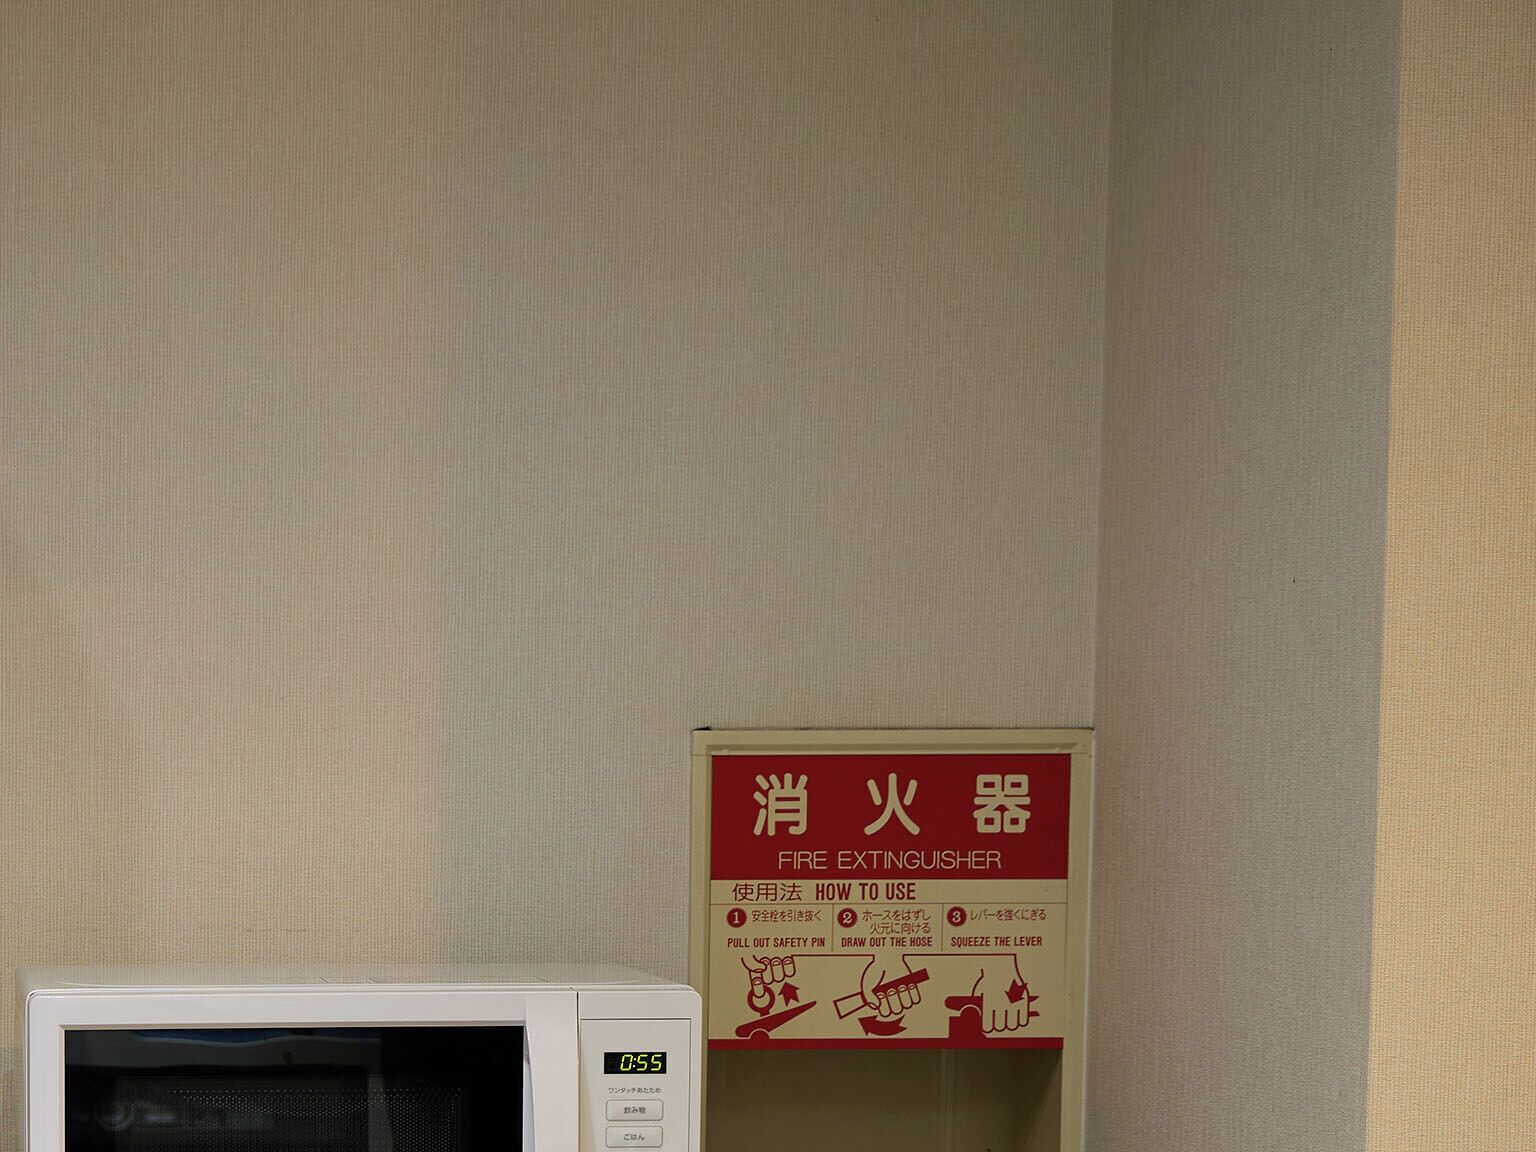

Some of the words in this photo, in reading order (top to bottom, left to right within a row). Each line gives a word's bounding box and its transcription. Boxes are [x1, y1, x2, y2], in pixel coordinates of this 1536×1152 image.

[778, 851, 827, 870] FIRE
[837, 850, 1002, 870] EXTINGUISHER
[732, 883, 802, 902] 使用法
[816, 883, 852, 900] HOW
[859, 883, 879, 900] TO
[886, 883, 916, 900] USE
[751, 909, 822, 923] 安全栓を引き抜く
[862, 908, 931, 922] ホースをはずし
[970, 908, 1047, 922] レバーを強くにぎる
[869, 922, 931, 935] 火元に向ける
[727, 937, 750, 948] PULL
[753, 937, 770, 948] OUT
[773, 937, 808, 948] SAFETY
[811, 937, 825, 948] PIN
[841, 937, 866, 948] DRAW
[869, 937, 887, 948] OUT
[890, 937, 907, 948] THE
[910, 937, 933, 948] HOSE
[950, 936, 991, 948] SQUEEZE
[994, 936, 1011, 947] THE
[1014, 936, 1043, 947] LEVER
[620, 1054, 662, 1071] 0:55
[623, 1106, 646, 1114] 飲み物
[623, 1133, 645, 1141] ごはん
